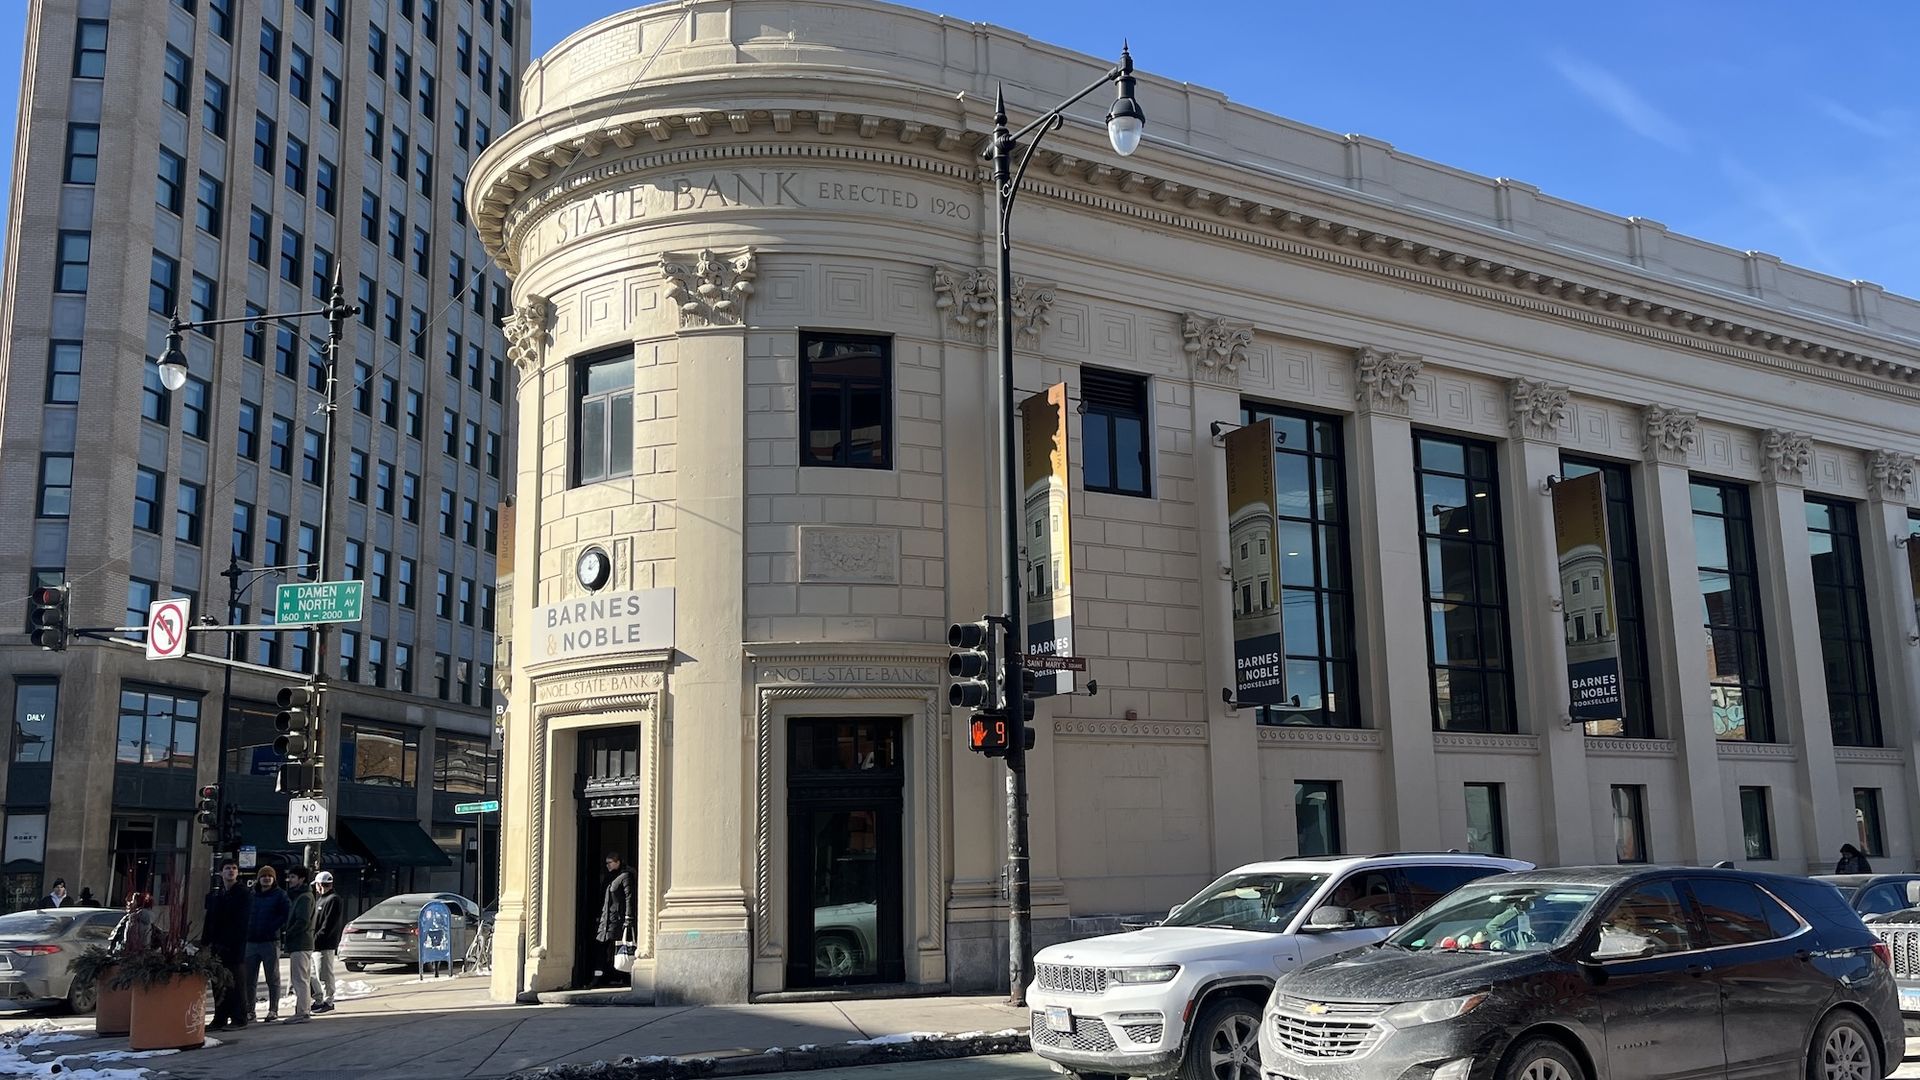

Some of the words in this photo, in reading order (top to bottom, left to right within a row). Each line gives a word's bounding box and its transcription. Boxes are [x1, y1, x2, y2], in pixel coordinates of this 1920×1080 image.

[556, 185, 647, 245] STATE
[672, 172, 807, 211] BANK
[818, 182, 919, 210] ERECTED
[930, 196, 971, 221] 1920
[283, 590, 290, 598] N
[297, 585, 338, 599] DAMEN
[345, 586, 357, 594] AV
[283, 602, 291, 611] W
[298, 598, 336, 611] NORTH
[343, 599, 355, 607] AV
[547, 595, 641, 629] BARNES
[281, 612, 300, 621] 1600
[304, 612, 311, 620] N
[321, 610, 343, 620] 2000
[348, 610, 355, 618] W
[563, 623, 641, 652] NOBLE
[1030, 637, 1069, 655] BARNES
[1026, 659, 1043, 668] SAINT
[1045, 660, 1067, 669] MARY'S
[1238, 652, 1279, 669] BARNES
[775, 667, 822, 682] NOEL
[827, 667, 877, 682] STATE
[881, 668, 926, 682] BANK
[1246, 665, 1279, 680] NOBLE
[546, 684, 572, 700] NOEL
[574, 677, 607, 696] STATE
[611, 674, 649, 692] BANK
[1238, 678, 1280, 691] BOOKSELLERS
[1571, 674, 1616, 689] BARNES
[1581, 685, 1618, 699] NOBLE
[995, 721, 1005, 744] 9
[302, 803, 316, 813] NO
[297, 815, 320, 824] TURN
[292, 827, 304, 836] ON
[308, 826, 324, 835] RED
